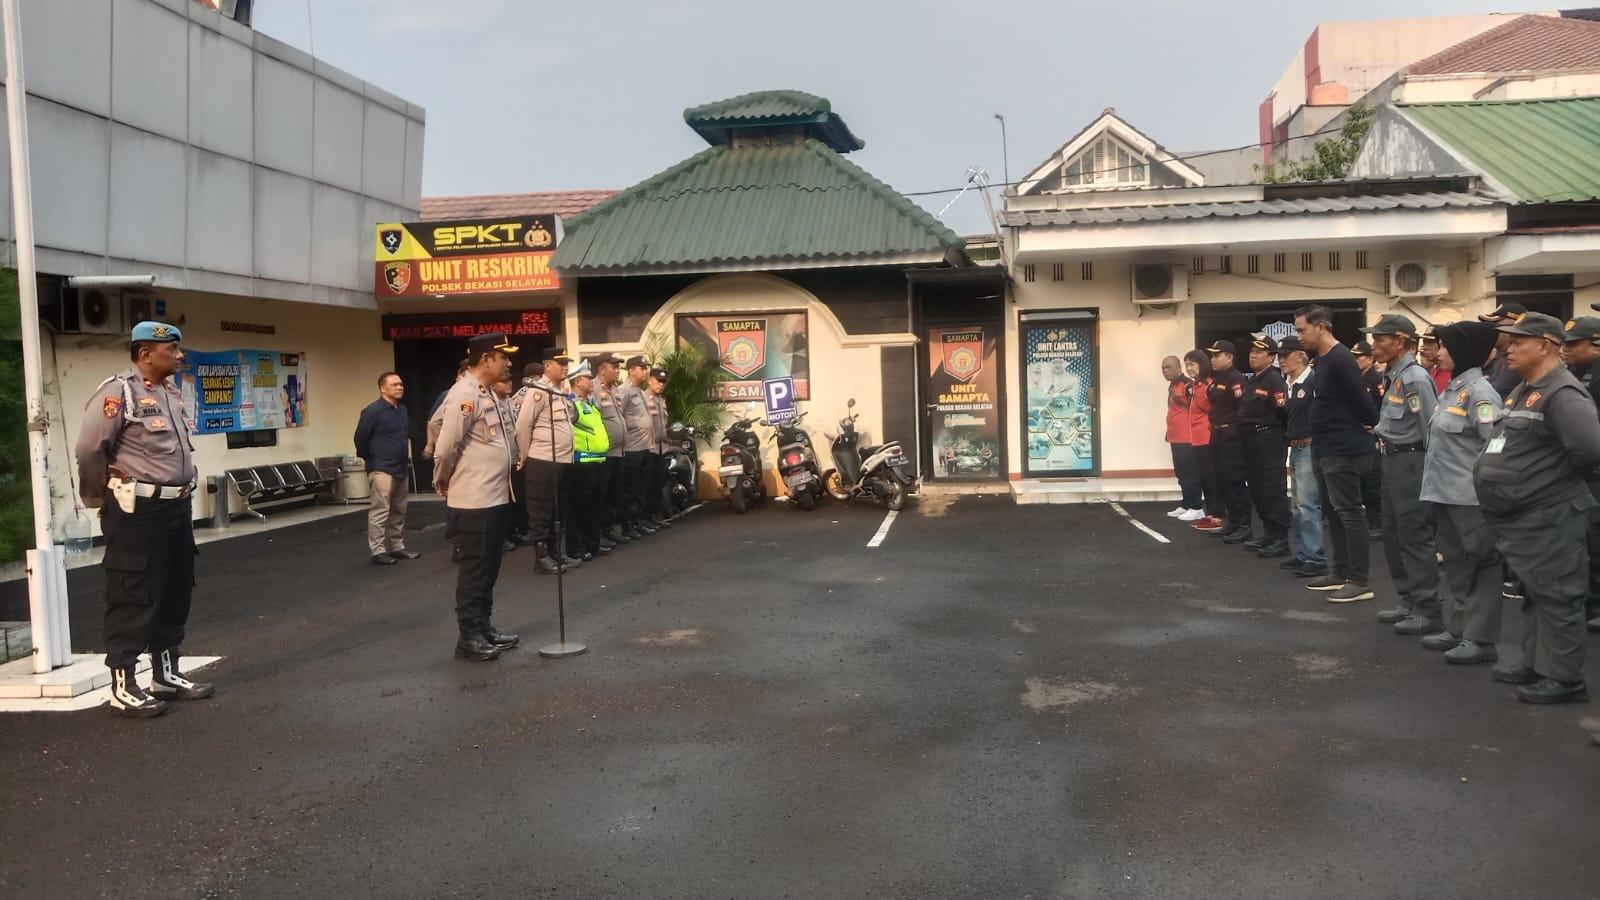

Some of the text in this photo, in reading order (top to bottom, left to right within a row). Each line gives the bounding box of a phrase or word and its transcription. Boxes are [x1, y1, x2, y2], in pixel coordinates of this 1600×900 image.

[433, 223, 522, 245] SPKT
[420, 255, 549, 282] UNIT RESKRIM
[422, 277, 550, 292] POLSEK BEKASI SELATAN
[515, 323, 549, 334] ANDA
[723, 322, 760, 331] SAMAPTA
[951, 384, 976, 392] UNIT
[769, 382, 788, 409] P
[939, 394, 989, 402] SAMAPTA
